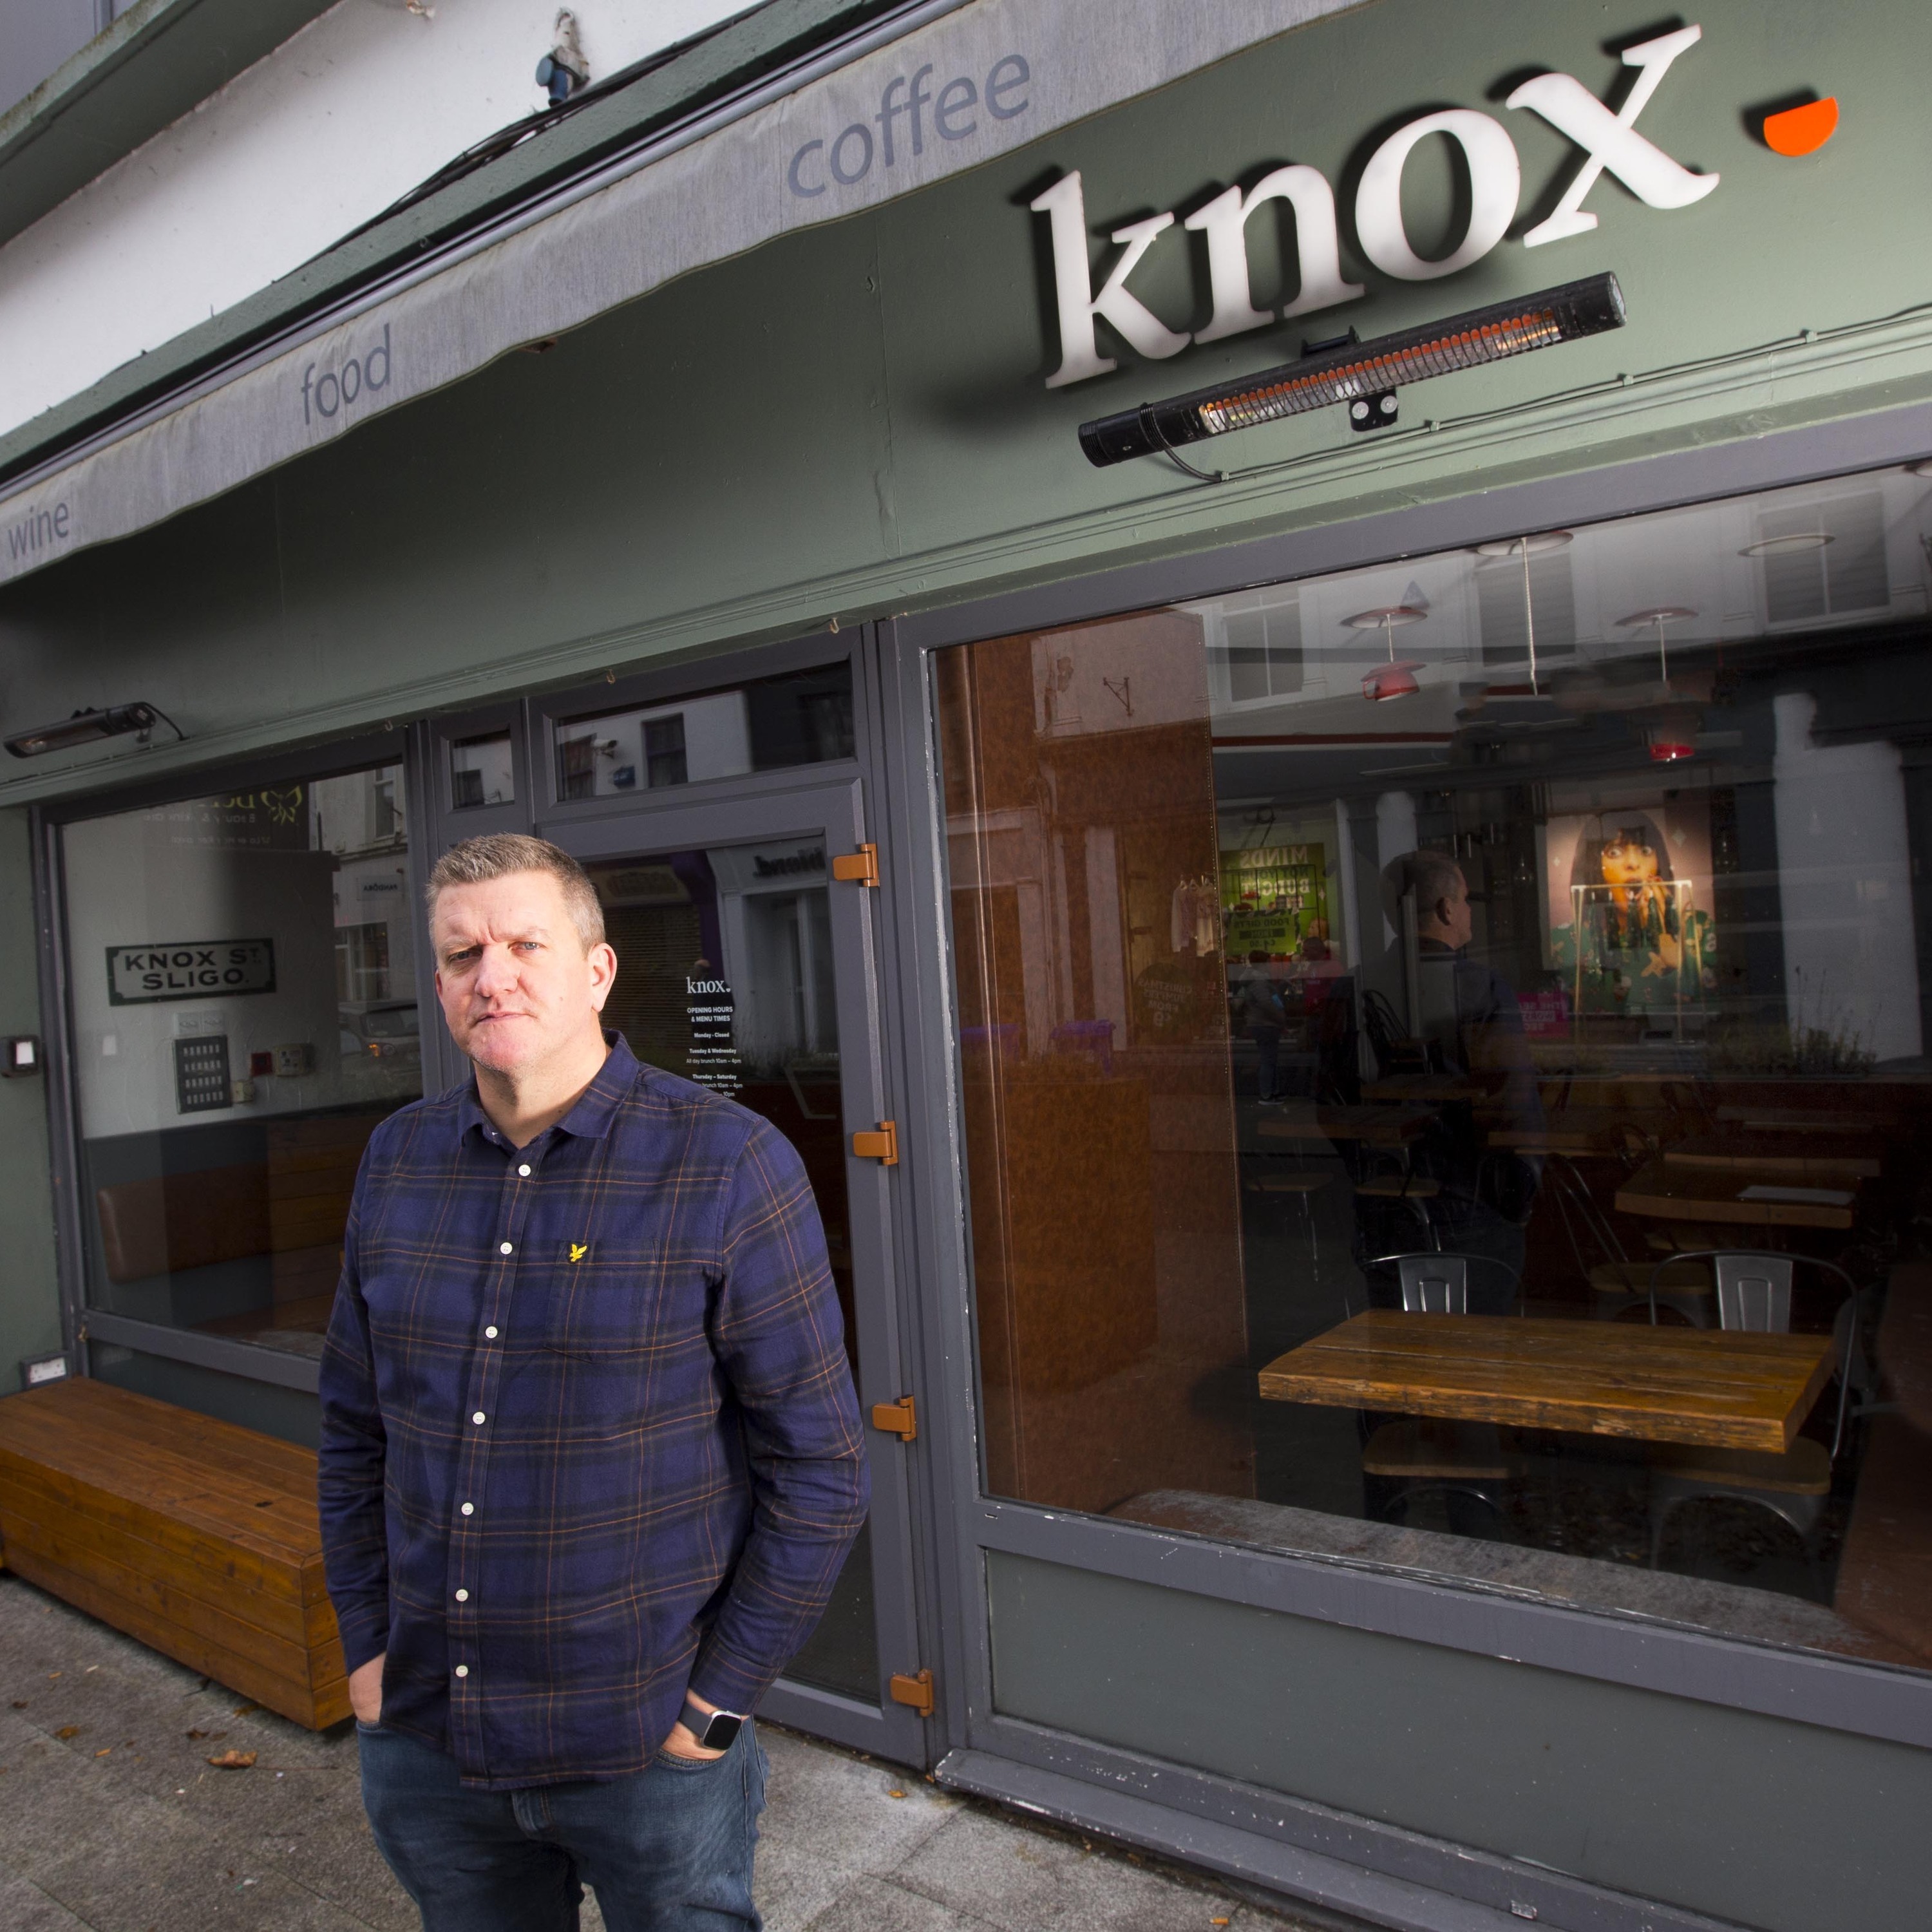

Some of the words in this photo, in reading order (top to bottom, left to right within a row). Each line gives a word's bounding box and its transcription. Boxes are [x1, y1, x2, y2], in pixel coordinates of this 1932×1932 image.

[788, 54, 1030, 197] coffee
[301, 323, 390, 425] food
[8, 502, 69, 560] wine
[124, 951, 217, 971] KNOX
